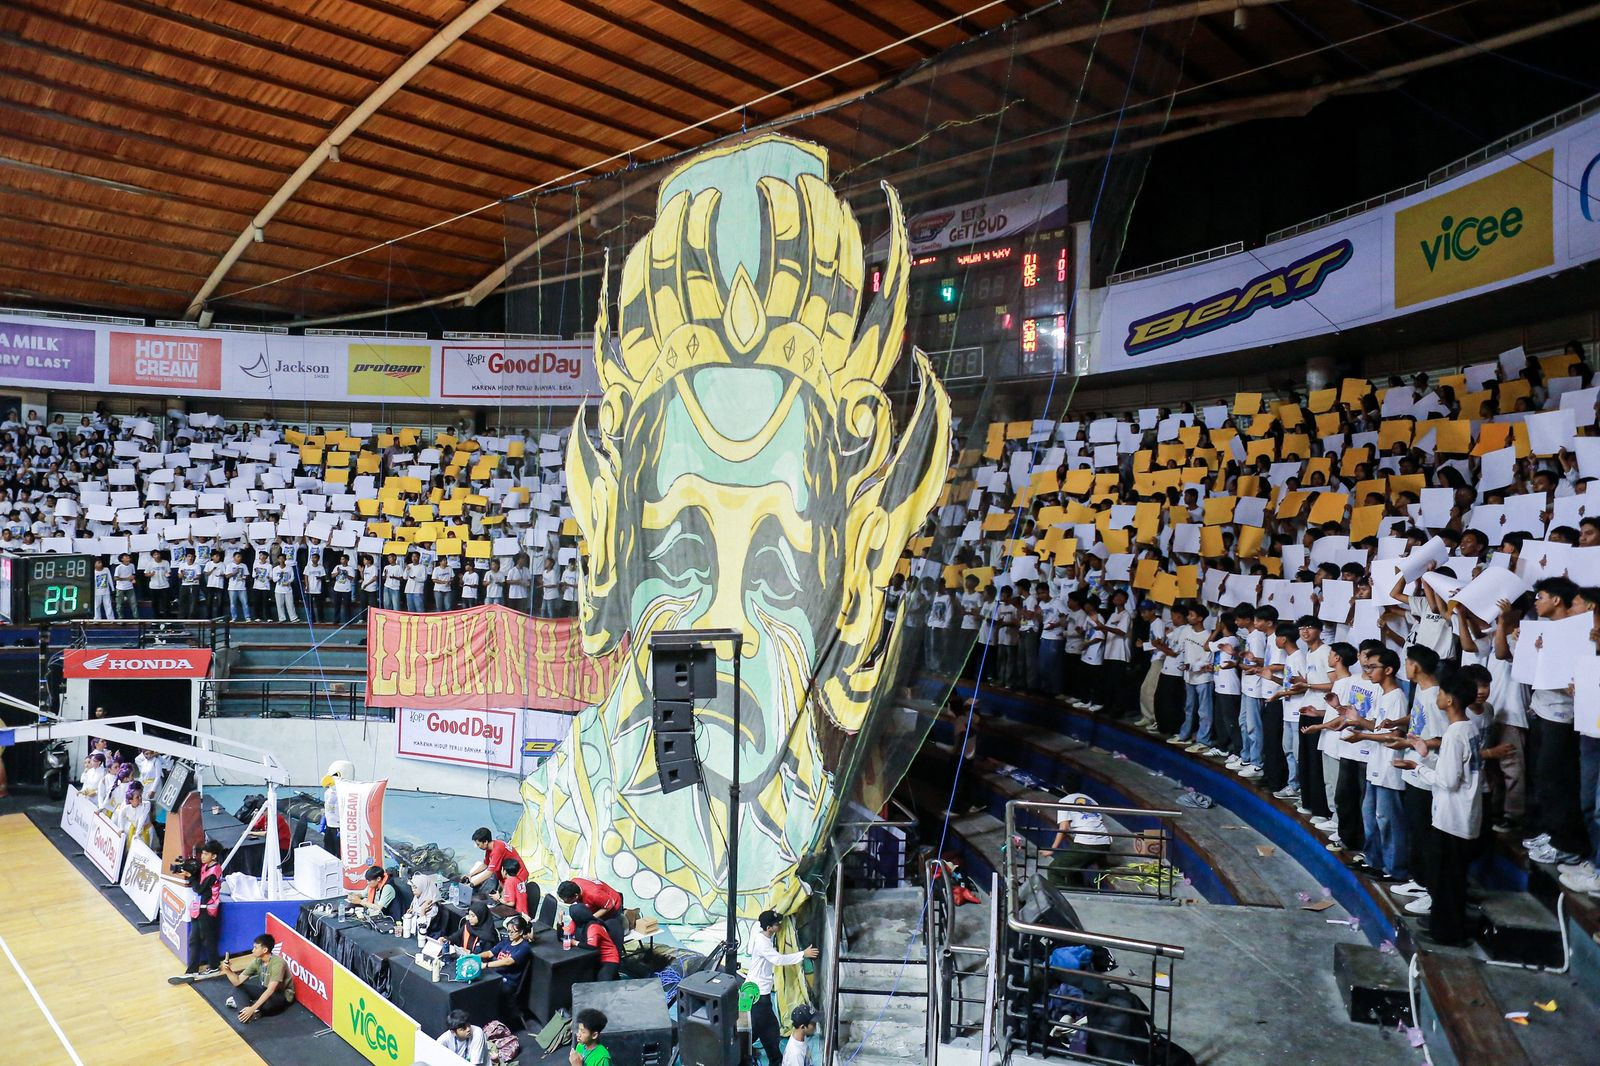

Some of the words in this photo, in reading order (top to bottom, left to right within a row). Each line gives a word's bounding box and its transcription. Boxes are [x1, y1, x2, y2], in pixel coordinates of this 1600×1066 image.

[949, 223, 973, 242] GET
[972, 215, 1008, 239] LOUD
[13, 334, 60, 352] MILK
[136, 339, 177, 360] HOT
[178, 342, 198, 361] IN
[26, 355, 71, 369] BLAST
[136, 358, 198, 378] CREAM
[275, 360, 330, 374] Jackson
[353, 363, 422, 373] proteam
[44, 585, 78, 616] 24
[108, 659, 194, 670] HONDA
[372, 611, 528, 697] LUPAKAN
[346, 792, 358, 832] CREAM
[282, 952, 328, 1000] HONDA
